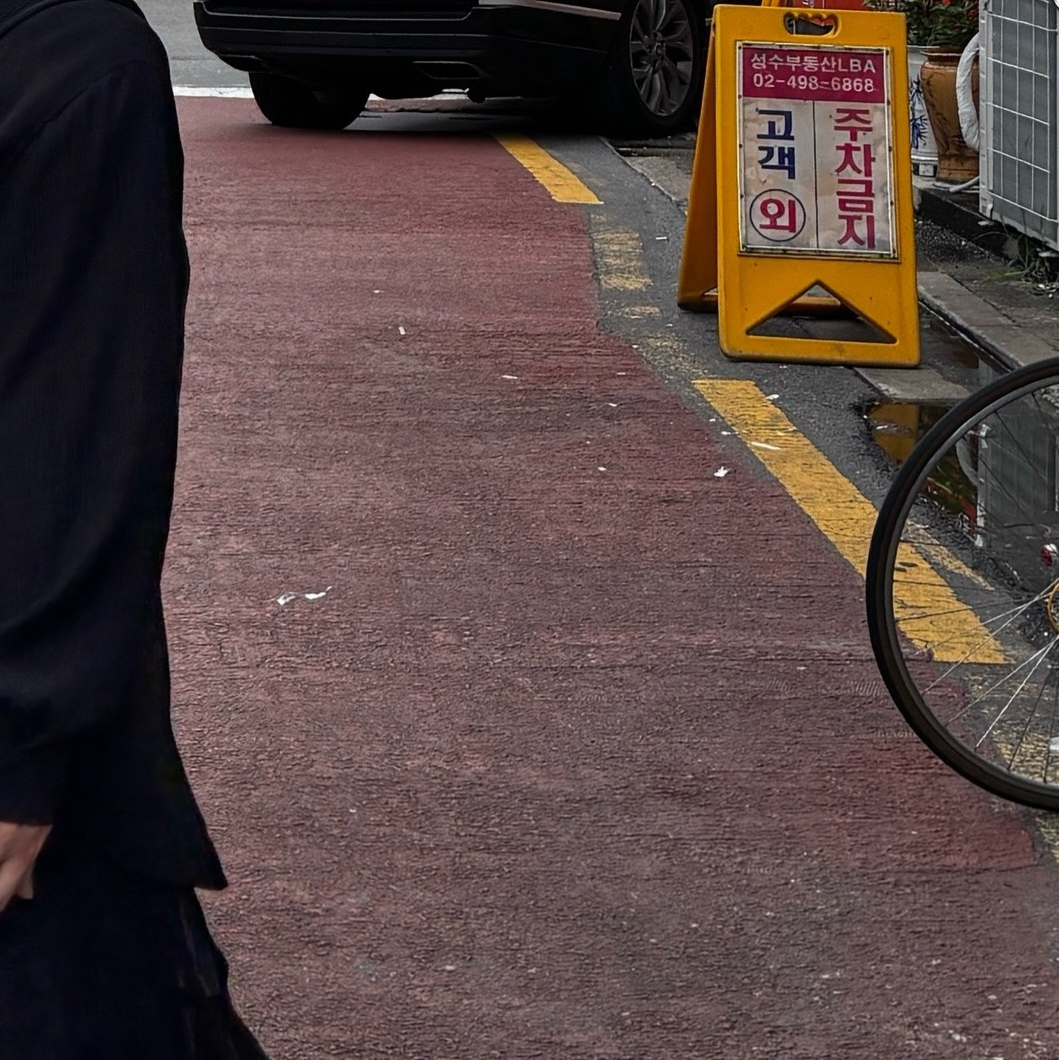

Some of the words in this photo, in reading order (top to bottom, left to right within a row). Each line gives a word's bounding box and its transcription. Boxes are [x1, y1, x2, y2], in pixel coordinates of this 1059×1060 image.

[751, 53, 876, 73] 성수부동산LBA
[753, 73, 875, 93] 02-498-6868
[756, 109, 796, 180] 고객
[833, 107, 877, 249] 주차금지
[758, 198, 797, 234] 외
